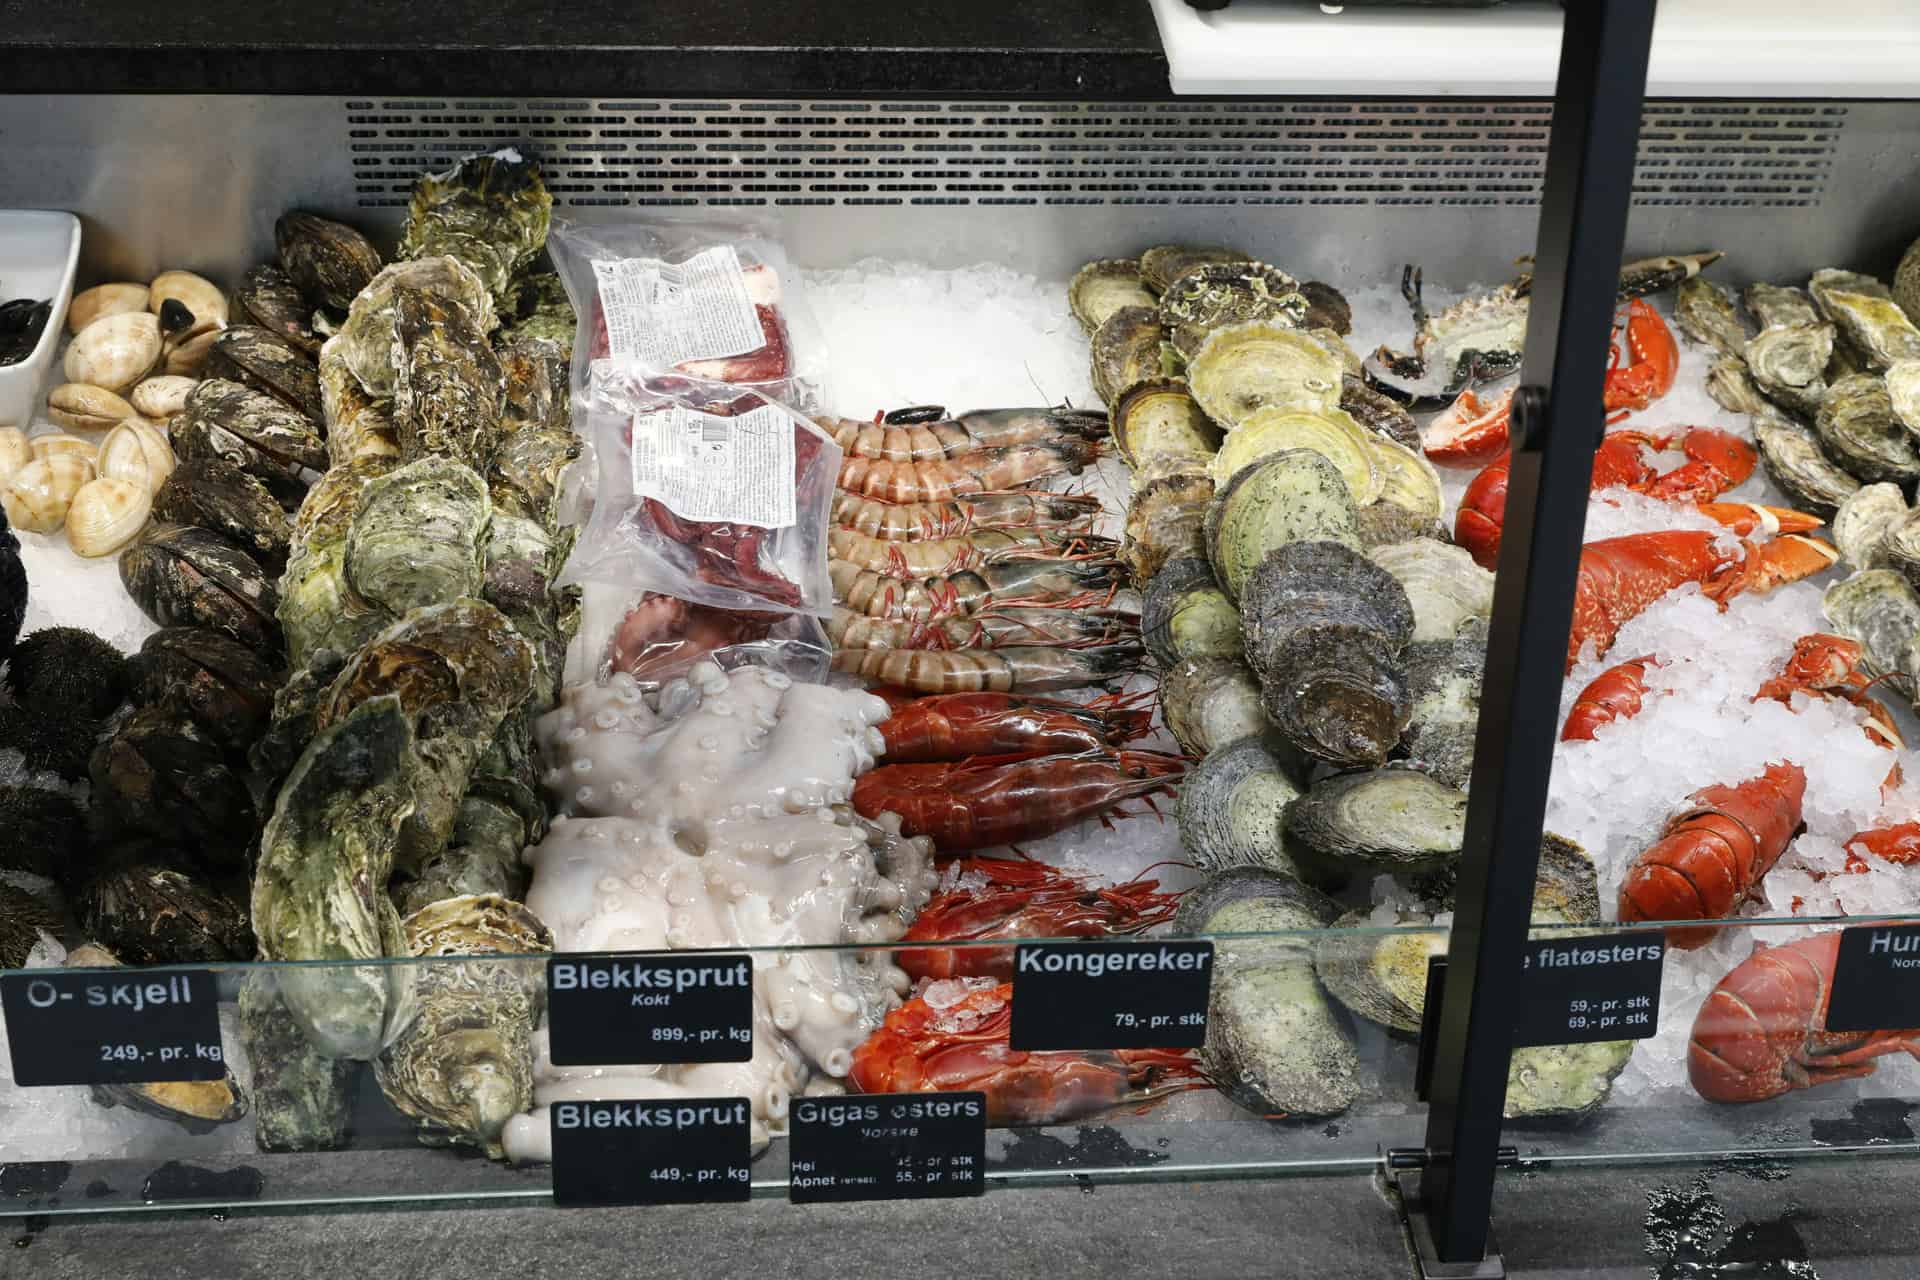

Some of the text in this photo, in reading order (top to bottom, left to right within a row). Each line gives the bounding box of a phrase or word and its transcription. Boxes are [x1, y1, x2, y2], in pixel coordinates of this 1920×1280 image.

[1019, 947, 1210, 977] Kongereker
[1538, 945, 1661, 968] flatøsters
[553, 962, 749, 993] Blekksprut
[85, 975, 192, 1011] skjell
[631, 993, 671, 1007] Kokt
[1570, 996, 1650, 1013] 59,- pr. stk
[1115, 1012, 1205, 1029] 79,- pr. stk
[1568, 1012, 1649, 1030] 69,- pr. stk
[652, 1026, 750, 1043] 899,- pr. kg
[100, 1043, 223, 1062] 249,- pr. kg
[557, 1103, 746, 1131] Blekksprut
[797, 1102, 880, 1127] Gigas
[650, 1166, 749, 1183] 449,- pr. kg
